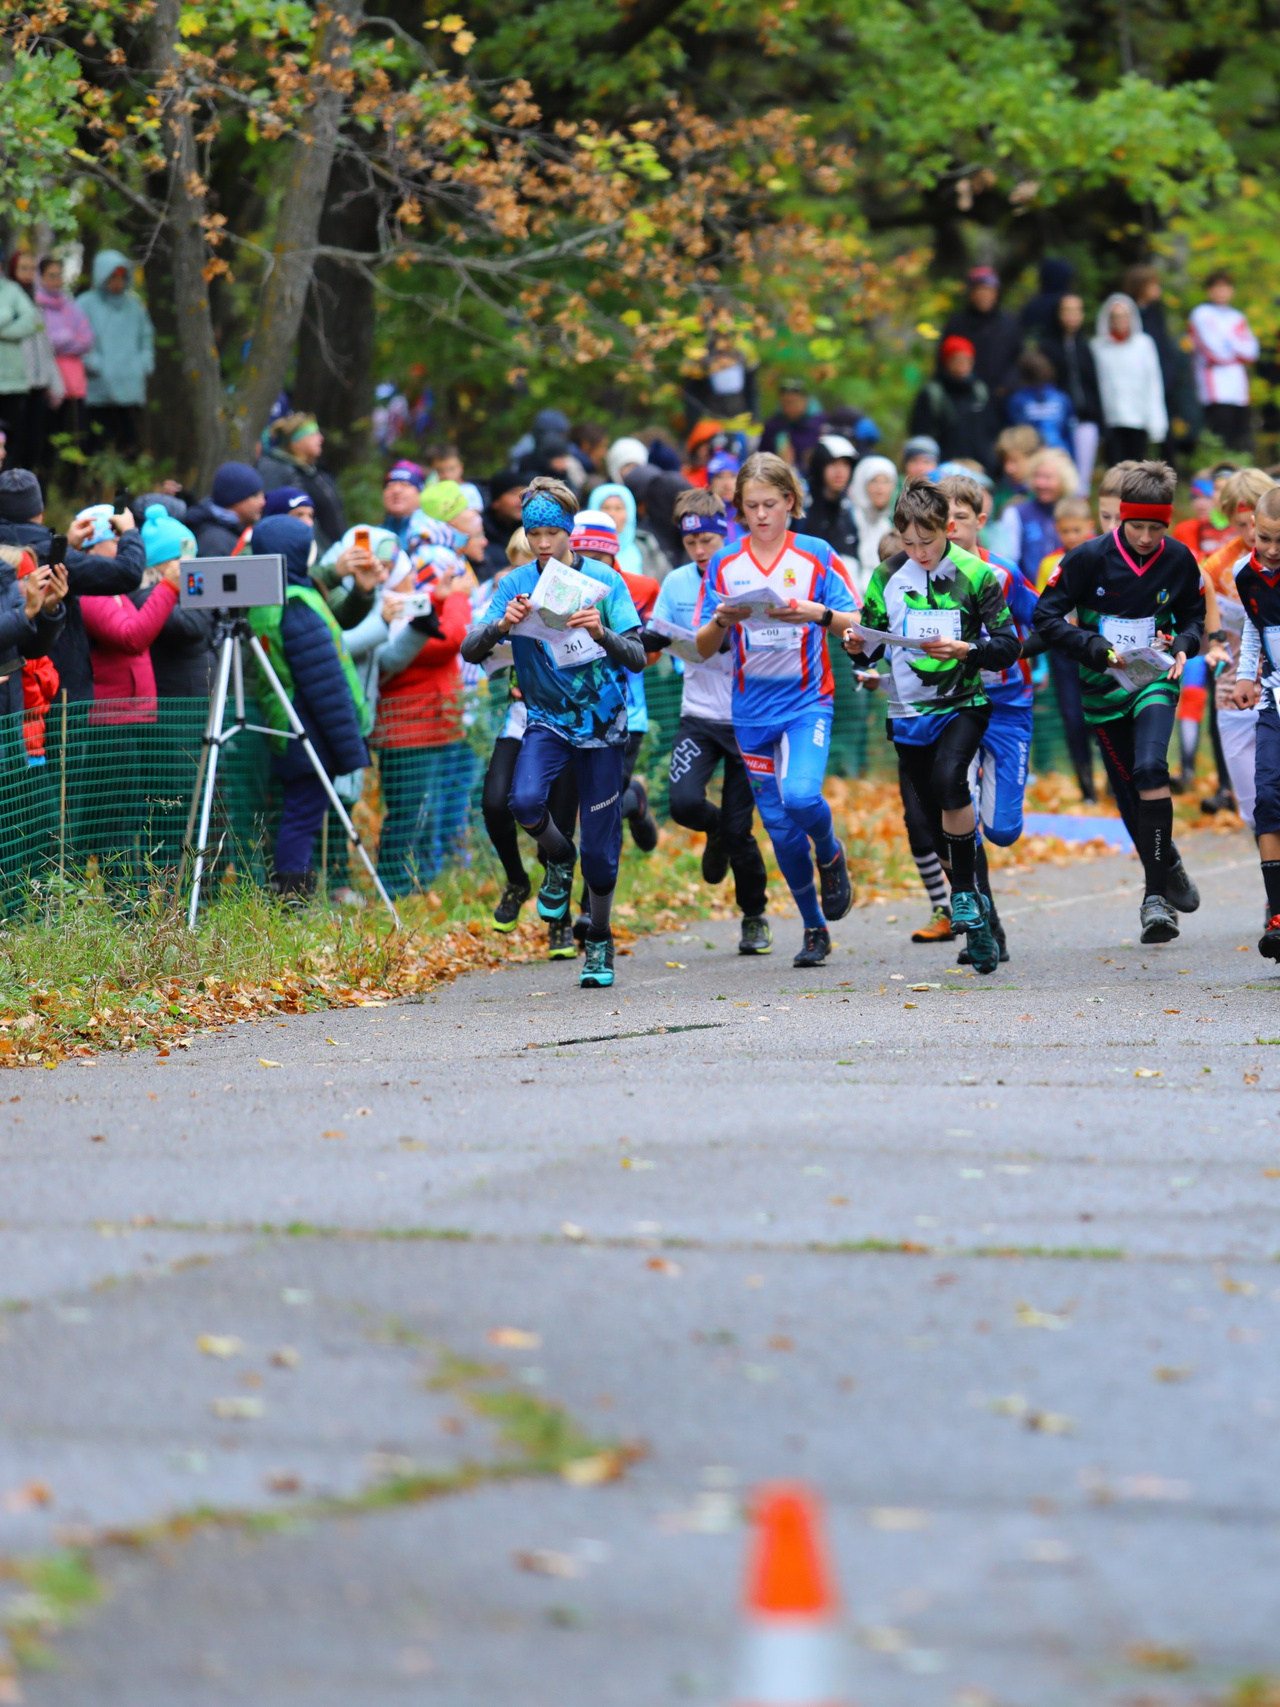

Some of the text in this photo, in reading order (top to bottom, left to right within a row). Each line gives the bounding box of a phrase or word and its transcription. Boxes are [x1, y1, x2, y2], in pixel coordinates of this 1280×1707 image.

[1116, 633, 1136, 645] 258
[564, 640, 583, 654] 261
[745, 759, 768, 770] НЕЖ
